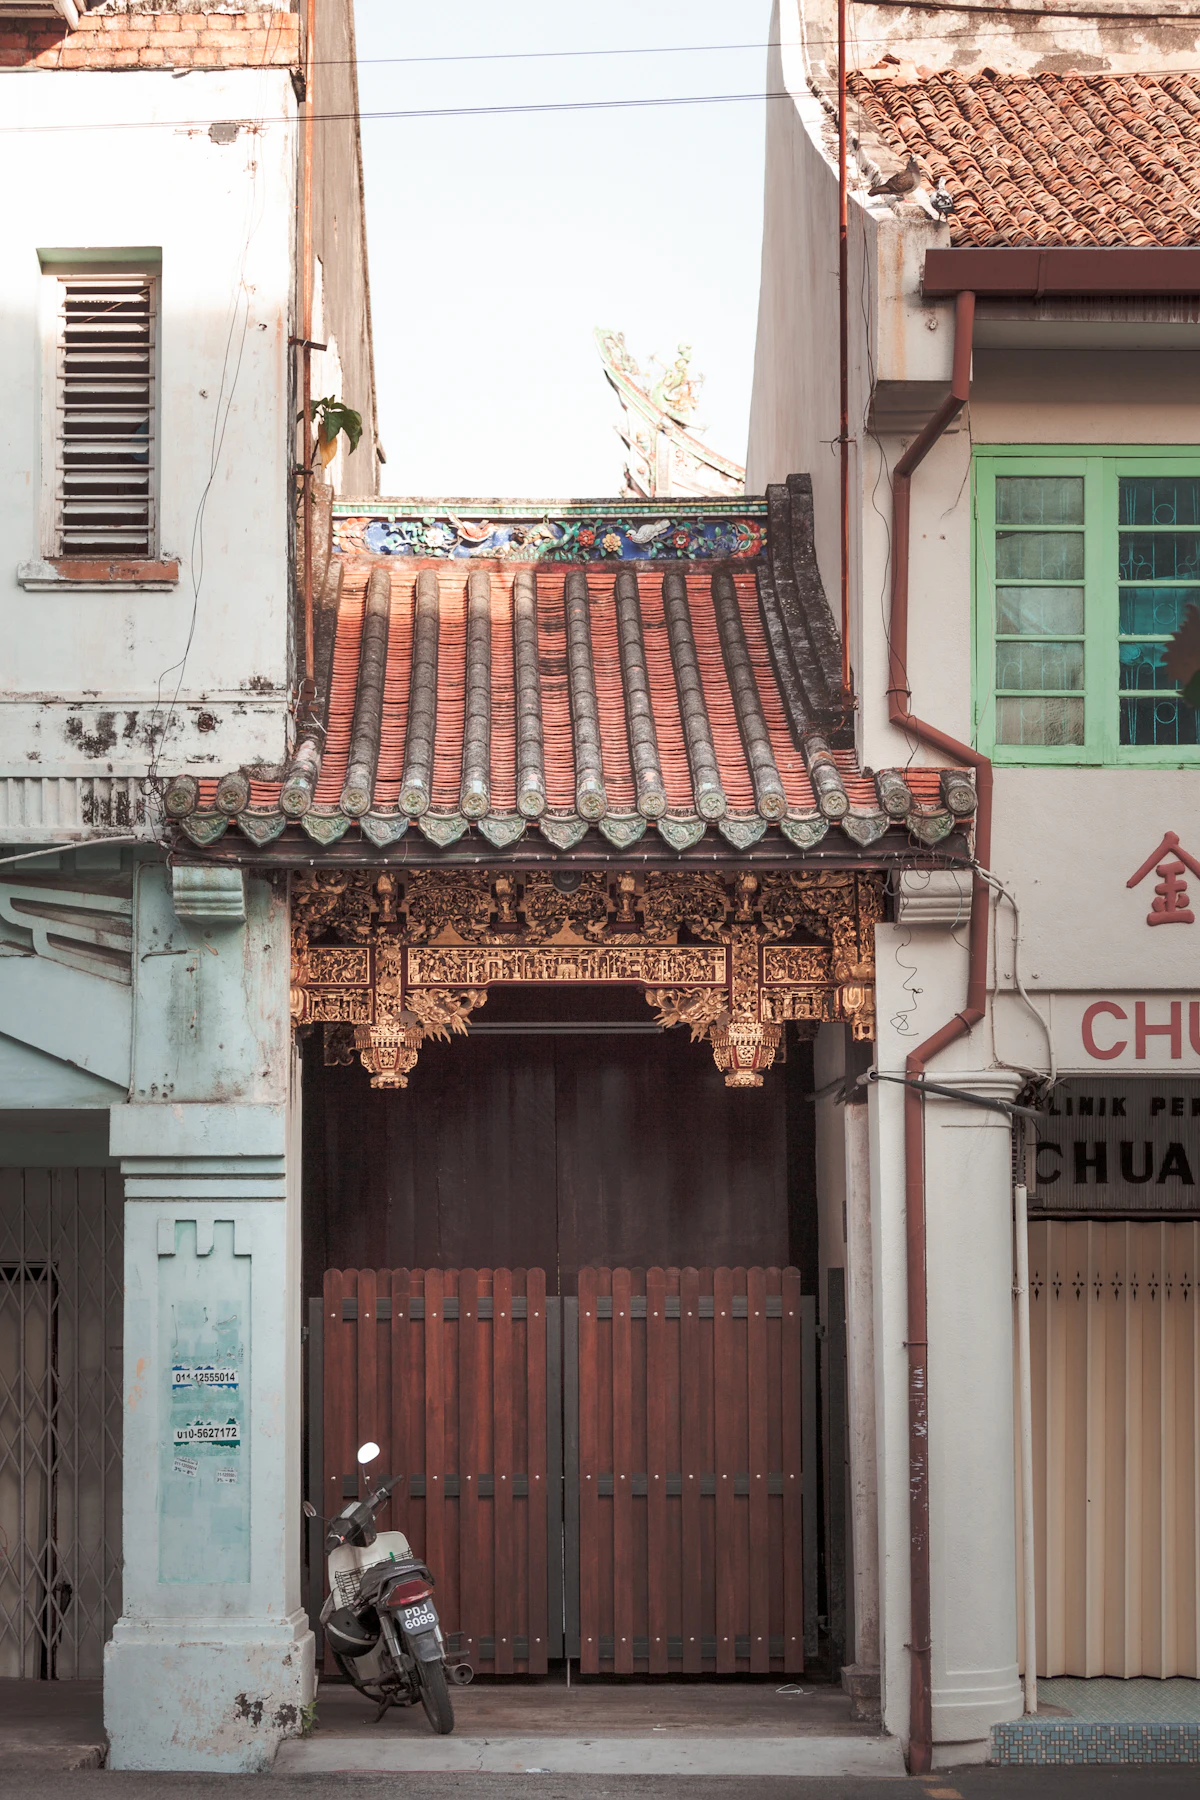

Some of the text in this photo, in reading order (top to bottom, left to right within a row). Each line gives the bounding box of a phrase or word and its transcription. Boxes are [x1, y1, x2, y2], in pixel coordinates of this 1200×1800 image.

[1126, 830, 1200, 926] 金
[1081, 1001, 1200, 1060] CH
[1035, 1097, 1126, 1117] LINIK
[1036, 1141, 1195, 1185] CHUA
[404, 1604, 428, 1619] PDJ
[404, 1613, 435, 1629] 6089
